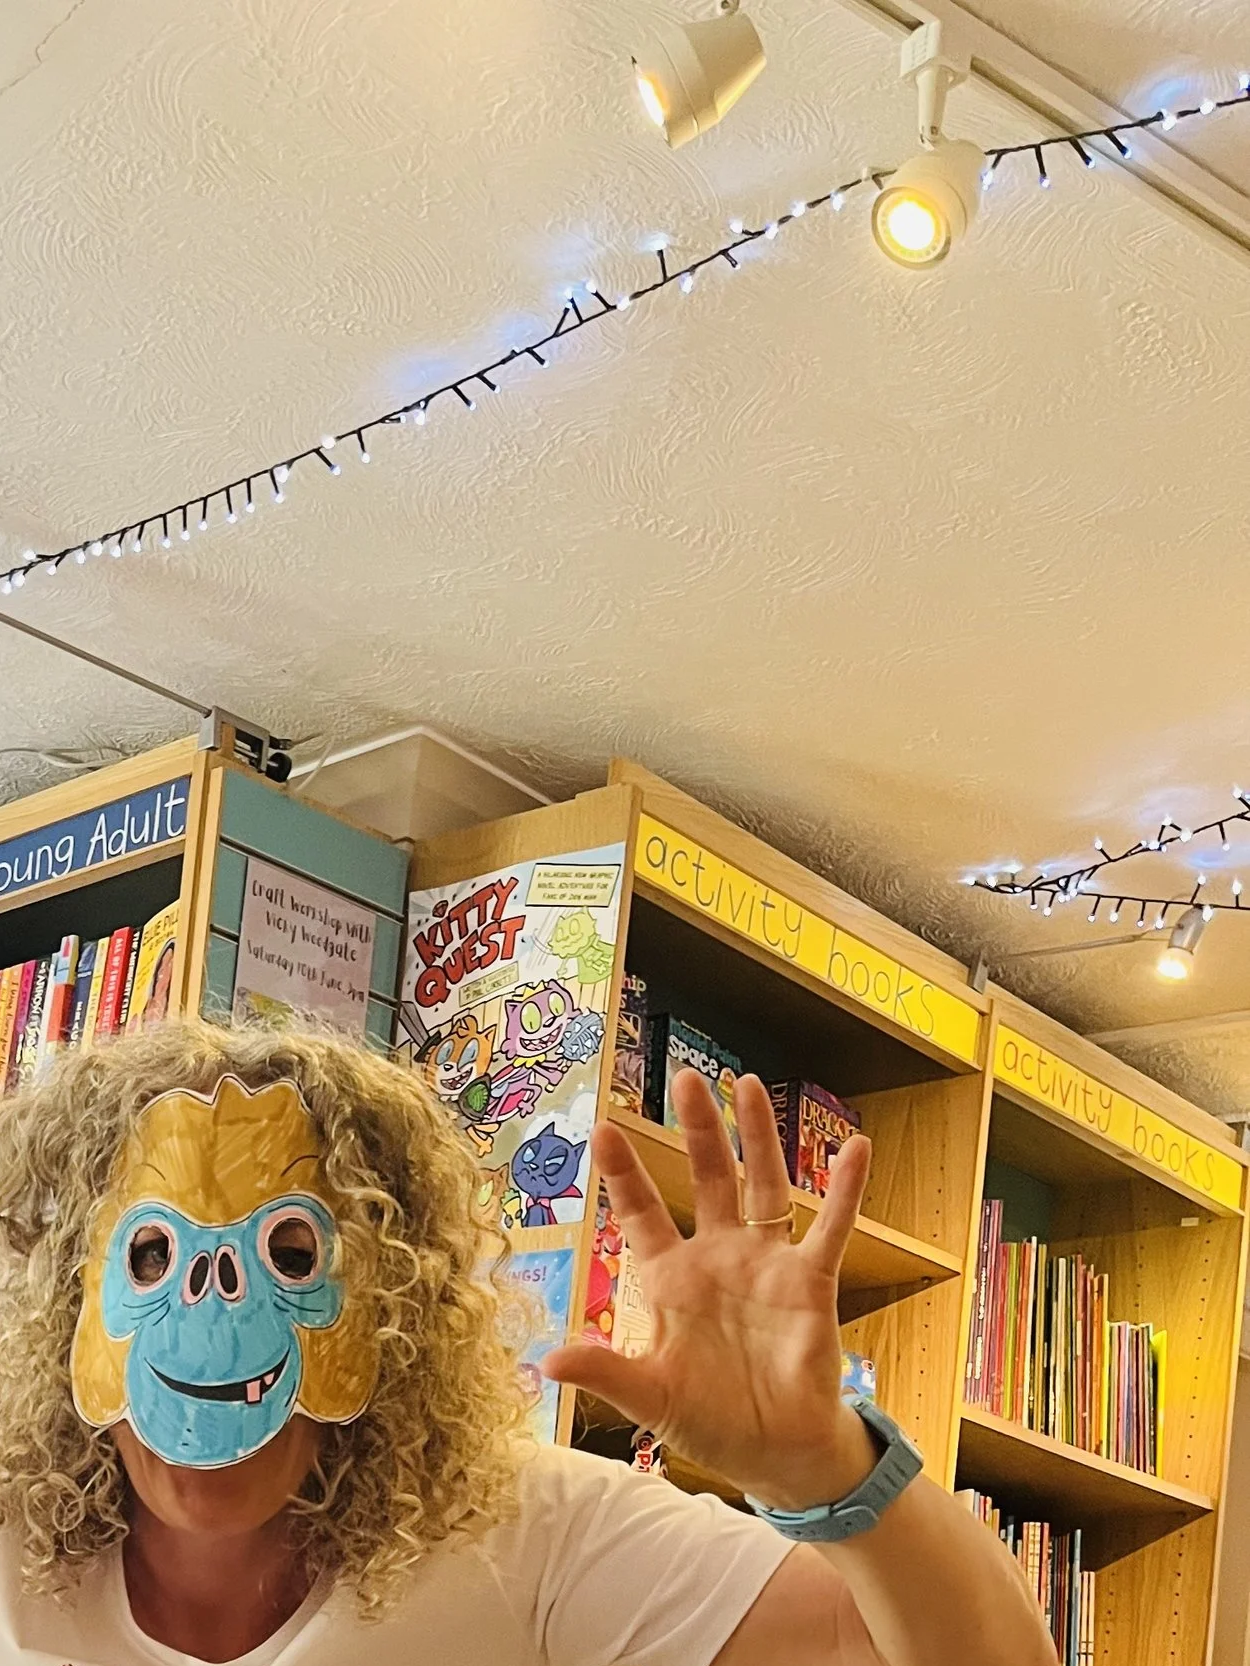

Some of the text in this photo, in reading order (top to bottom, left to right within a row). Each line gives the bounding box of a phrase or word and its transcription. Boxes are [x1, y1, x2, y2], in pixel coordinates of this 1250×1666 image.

[85, 790, 187, 867] Adult
[413, 876, 519, 967] KITTY
[415, 915, 526, 1008] QUEST
[644, 835, 937, 1038] activity books
[1000, 1040, 1217, 1193] activity books
